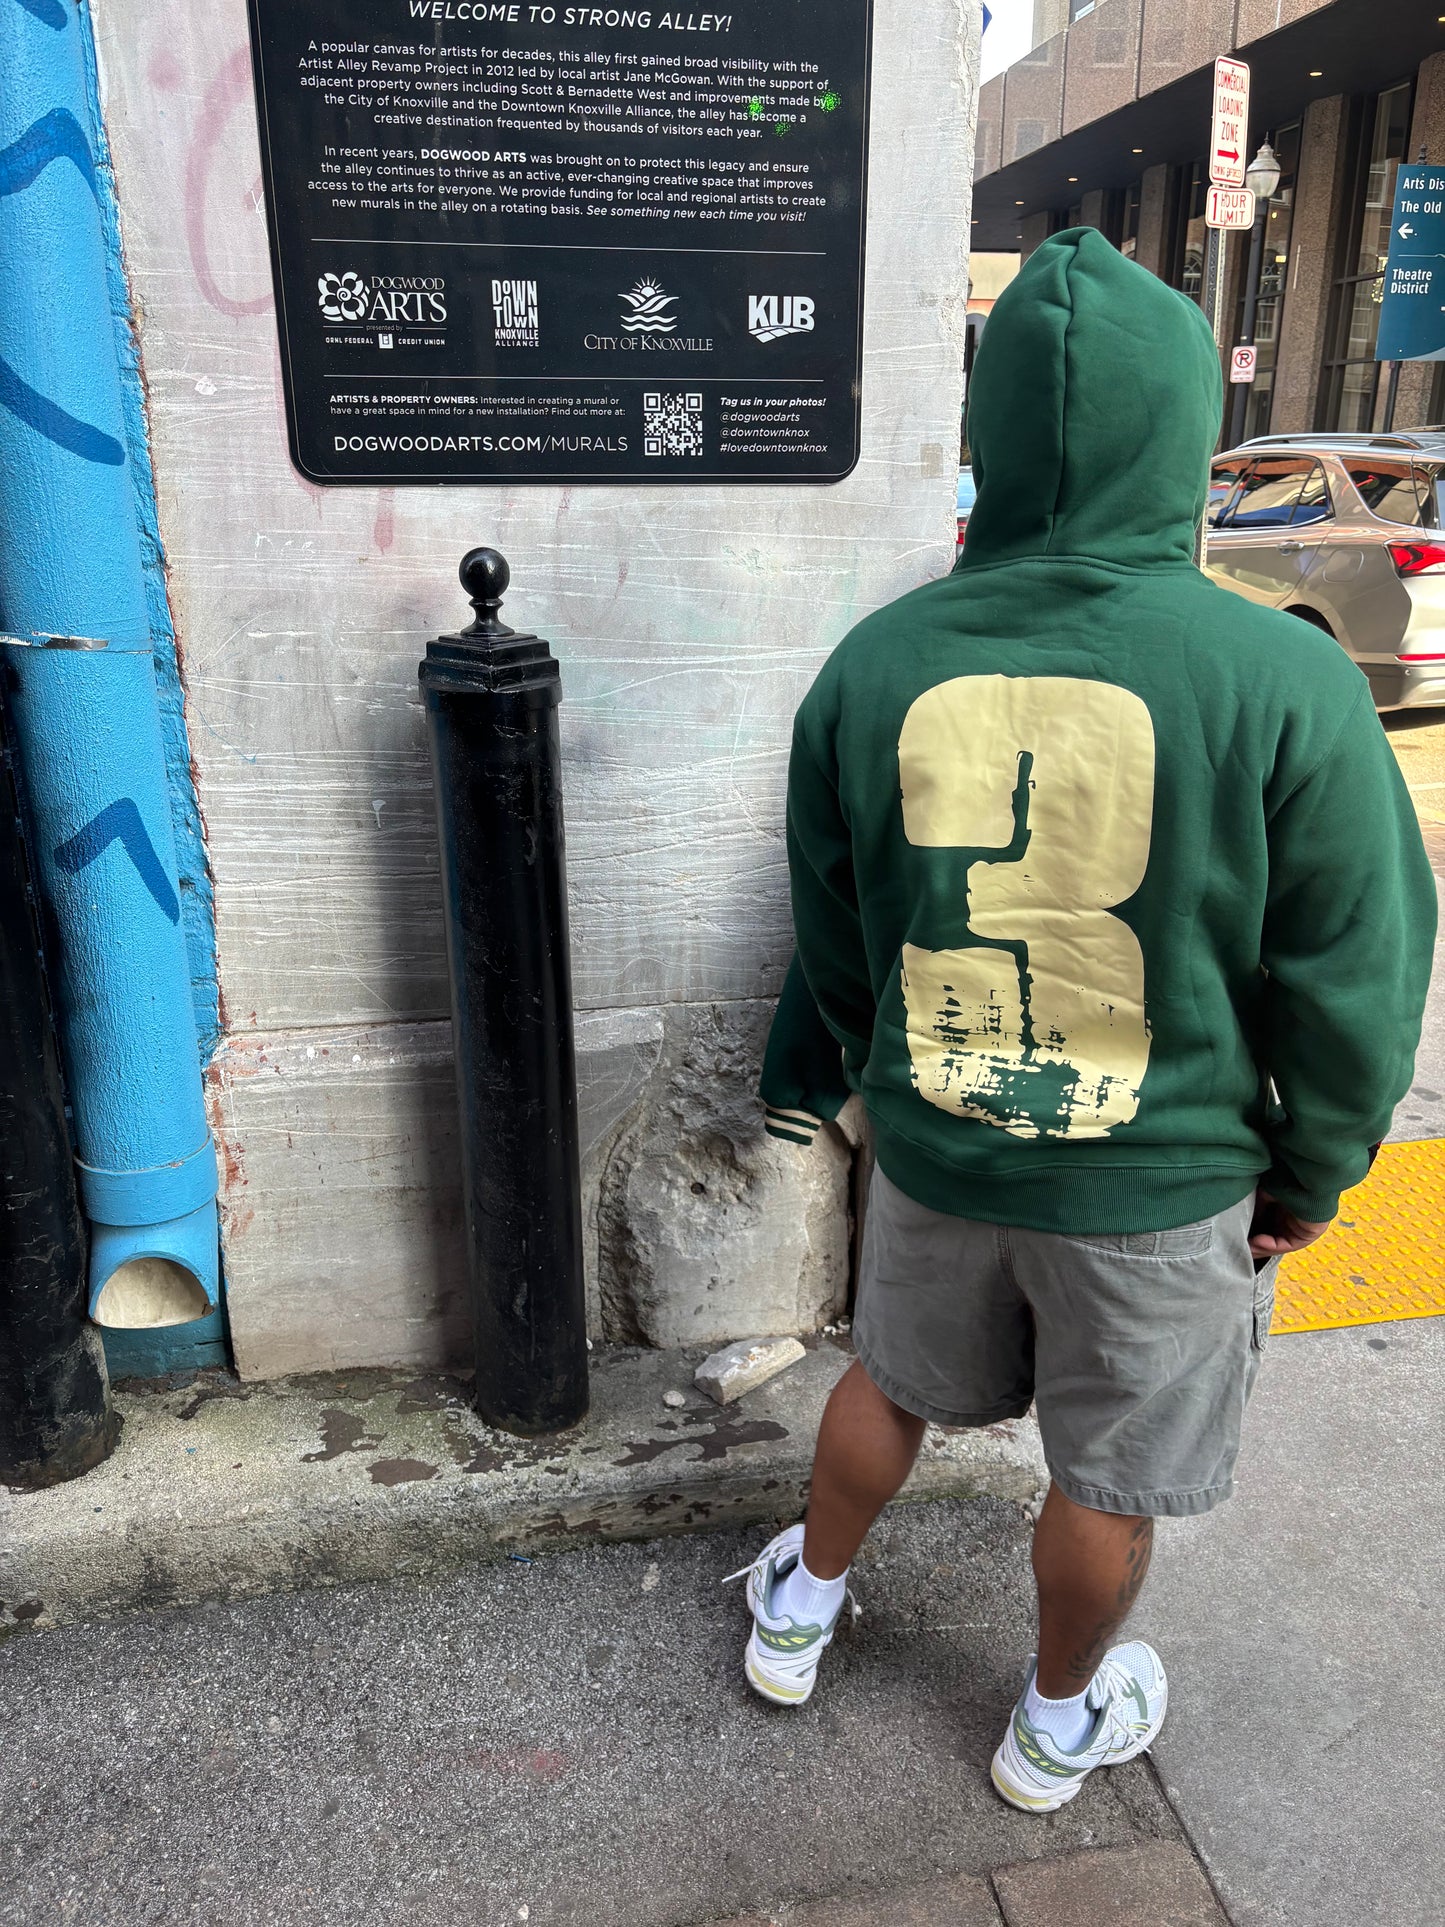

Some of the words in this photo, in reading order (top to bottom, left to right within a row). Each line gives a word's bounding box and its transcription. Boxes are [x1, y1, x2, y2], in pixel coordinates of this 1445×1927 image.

[410, 0, 520, 22] WELCOME
[528, 6, 556, 24] TO
[563, 7, 652, 28] STRONG
[658, 12, 732, 32] ALLEY!
[308, 40, 318, 51] A
[322, 41, 370, 54] popular
[374, 45, 415, 55] canvas
[418, 44, 436, 56] for
[440, 46, 478, 58] artists
[481, 46, 498, 58] for
[502, 48, 555, 63] decades,
[559, 50, 580, 62] this
[584, 51, 611, 65] alley
[614, 52, 638, 65] first
[641, 54, 681, 67] gained
[684, 56, 718, 68] broad
[722, 58, 769, 73] visibility
[772, 61, 797, 72] with
[800, 61, 819, 73] the
[1217, 70, 1246, 94] COMMERCIAL
[324, 93, 344, 105] the
[348, 94, 373, 108] City
[377, 95, 389, 106] of
[393, 96, 448, 109] Knoxville
[452, 98, 474, 110] and
[478, 99, 498, 111] the
[502, 100, 565, 113] Downtown
[568, 103, 622, 116] Knoxville
[625, 105, 674, 119] Alliance,
[677, 107, 696, 119] the
[699, 108, 726, 121] alley
[729, 109, 749, 121] has
[751, 110, 797, 122] become
[800, 114, 806, 123] a
[1219, 95, 1243, 117] LOADING
[374, 113, 422, 125] creative
[426, 115, 493, 127] destination
[497, 117, 562, 130] frequented
[566, 119, 580, 133] by
[584, 121, 643, 134] thousands
[647, 123, 659, 134] of
[662, 124, 703, 136] visitors
[706, 126, 733, 137] each
[736, 129, 763, 139] year.
[1221, 121, 1238, 143] ZONE
[325, 145, 336, 156] In
[340, 147, 378, 158] recent
[382, 149, 417, 160] years,
[421, 148, 490, 161] DOGWOOD
[494, 151, 527, 163] ARTS
[530, 155, 553, 164] was
[556, 153, 603, 167] brought
[606, 157, 621, 166] on
[624, 157, 636, 167] to
[640, 158, 681, 169] protect
[685, 158, 705, 169] this
[709, 159, 745, 173] legacy
[748, 161, 769, 172] and
[772, 163, 809, 173] ensure
[321, 162, 341, 173] the
[345, 163, 373, 176] alley
[376, 165, 435, 177] continues
[438, 167, 451, 177] to
[454, 167, 489, 179] thrive
[492, 170, 505, 179] as
[508, 171, 522, 180] an
[526, 170, 564, 183] active,
[568, 172, 650, 186] ever-changing
[654, 175, 698, 186] creative
[702, 178, 734, 188] space
[737, 177, 760, 188] that
[763, 177, 813, 190] improves
[1403, 177, 1425, 190] Arts
[1428, 178, 1445, 190] Dis
[332, 199, 357, 208] new
[360, 198, 400, 209] murals
[404, 199, 414, 209] in
[418, 200, 437, 211] the
[441, 200, 468, 214] alley
[472, 203, 487, 212] on
[490, 204, 497, 212] a
[501, 203, 547, 216] rotating
[551, 204, 583, 215] basis.
[586, 205, 608, 216] See
[610, 206, 670, 220] something
[673, 210, 697, 218] new
[700, 209, 726, 219] each
[729, 209, 754, 220] time
[756, 212, 777, 222] you
[780, 211, 807, 222] visit!
[1213, 193, 1218, 221] 1
[1221, 193, 1247, 208] HOUR
[1220, 209, 1246, 223] LIMIT
[1401, 201, 1420, 213] The
[1423, 201, 1442, 214] Old
[371, 276, 445, 290] DOGWOOD
[1392, 268, 1432, 281] Theatre
[1390, 281, 1429, 294] District
[368, 291, 447, 322] ARTS
[749, 295, 815, 331] KUB
[345, 337, 374, 345] FEDERAL
[424, 338, 446, 346] UNION
[495, 328, 539, 340] KNOXVILLE
[330, 395, 370, 403] ARTISTS
[372, 395, 378, 403] &
[381, 395, 431, 404] PROPERTY
[433, 396, 478, 404] OWNERS:
[481, 396, 525, 404] Interested
[538, 397, 573, 406] creating
[584, 397, 608, 405] mural
[720, 397, 738, 408] Tag
[753, 397, 763, 406] in
[764, 399, 788, 408] your
[789, 397, 827, 408] photos!
[330, 406, 352, 415] have
[362, 407, 387, 416] great
[389, 408, 415, 416] space
[428, 407, 451, 415] mind
[453, 407, 466, 415] for
[497, 407, 549, 415] installation?
[551, 407, 571, 415] Find
[573, 408, 588, 416] out
[614, 408, 626, 416] at:
[720, 412, 800, 423] @dogwoodarts
[720, 427, 810, 438] @downtownknox
[334, 435, 628, 453] DOGWOODARTS.COM/MURALS
[720, 443, 828, 453] #lovedowntownknox
[899, 673, 1156, 1139] 3
